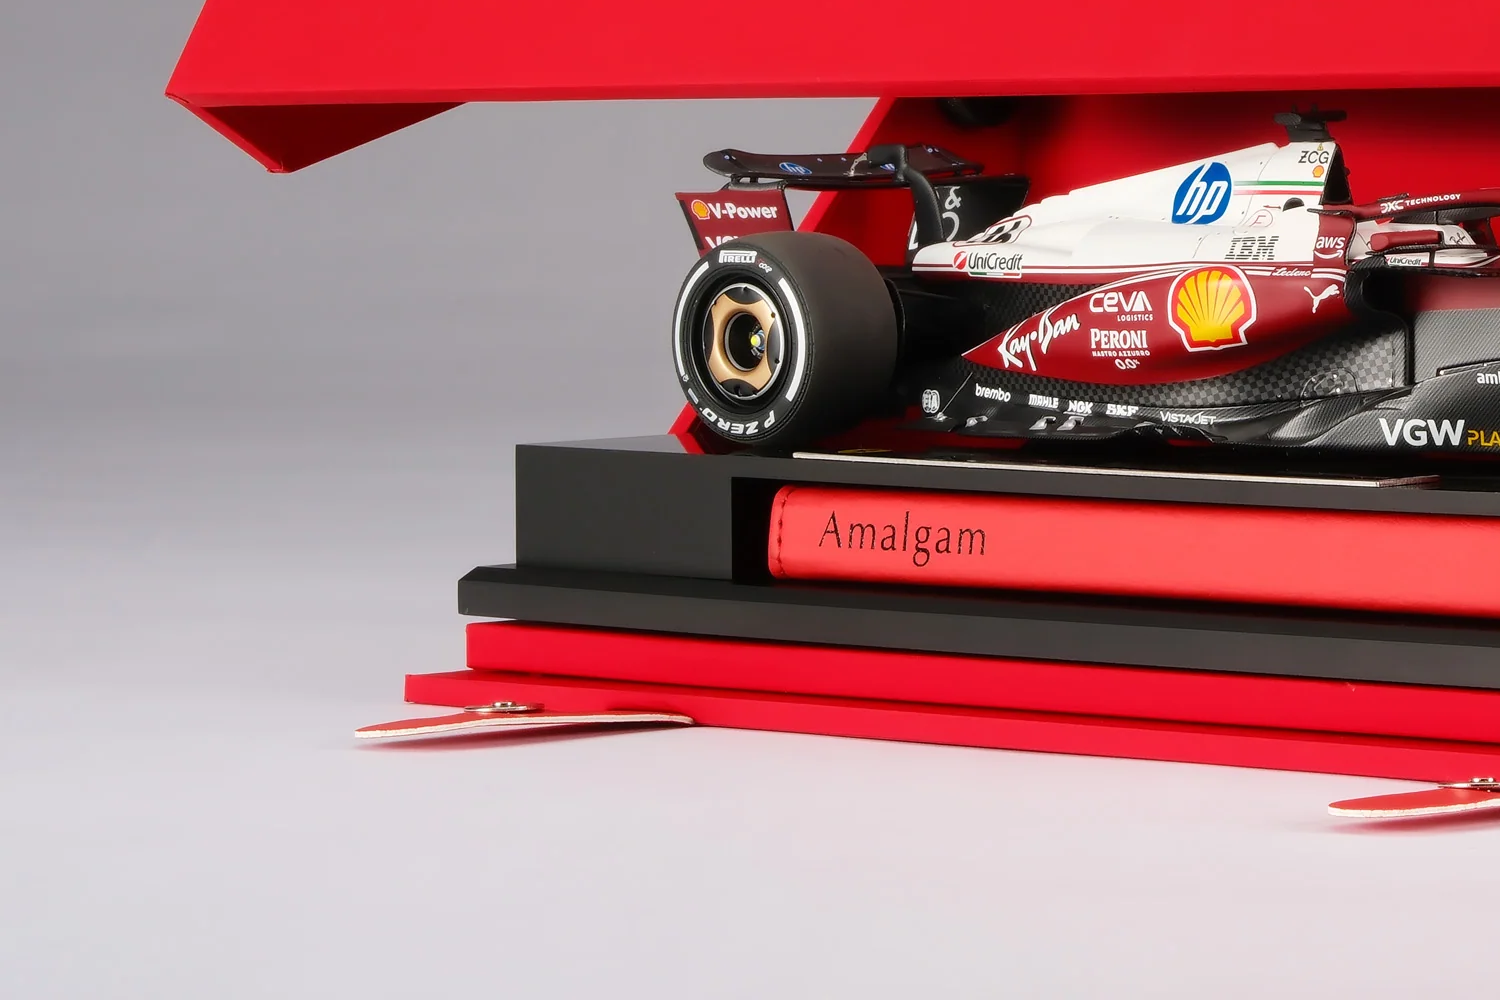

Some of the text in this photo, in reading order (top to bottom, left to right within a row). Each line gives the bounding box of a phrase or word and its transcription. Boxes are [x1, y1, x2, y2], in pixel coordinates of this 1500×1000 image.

[1173, 162, 1232, 224] hp
[1405, 193, 1461, 206] TECHNOLOGY
[709, 203, 778, 218] V-Power
[1224, 236, 1280, 260] IBM
[1316, 236, 1346, 249] aws
[719, 250, 757, 263] PIRELLI
[968, 252, 1023, 270] UniCredit
[1090, 328, 1148, 349] PERONI
[975, 383, 1011, 402] brembo
[1028, 394, 1059, 409] MAHLE
[1068, 400, 1094, 414] NGK
[1106, 403, 1139, 416] SKF
[699, 407, 776, 435] P ZERO
[1379, 418, 1465, 446] VGW
[818, 510, 986, 567] Amalgam
